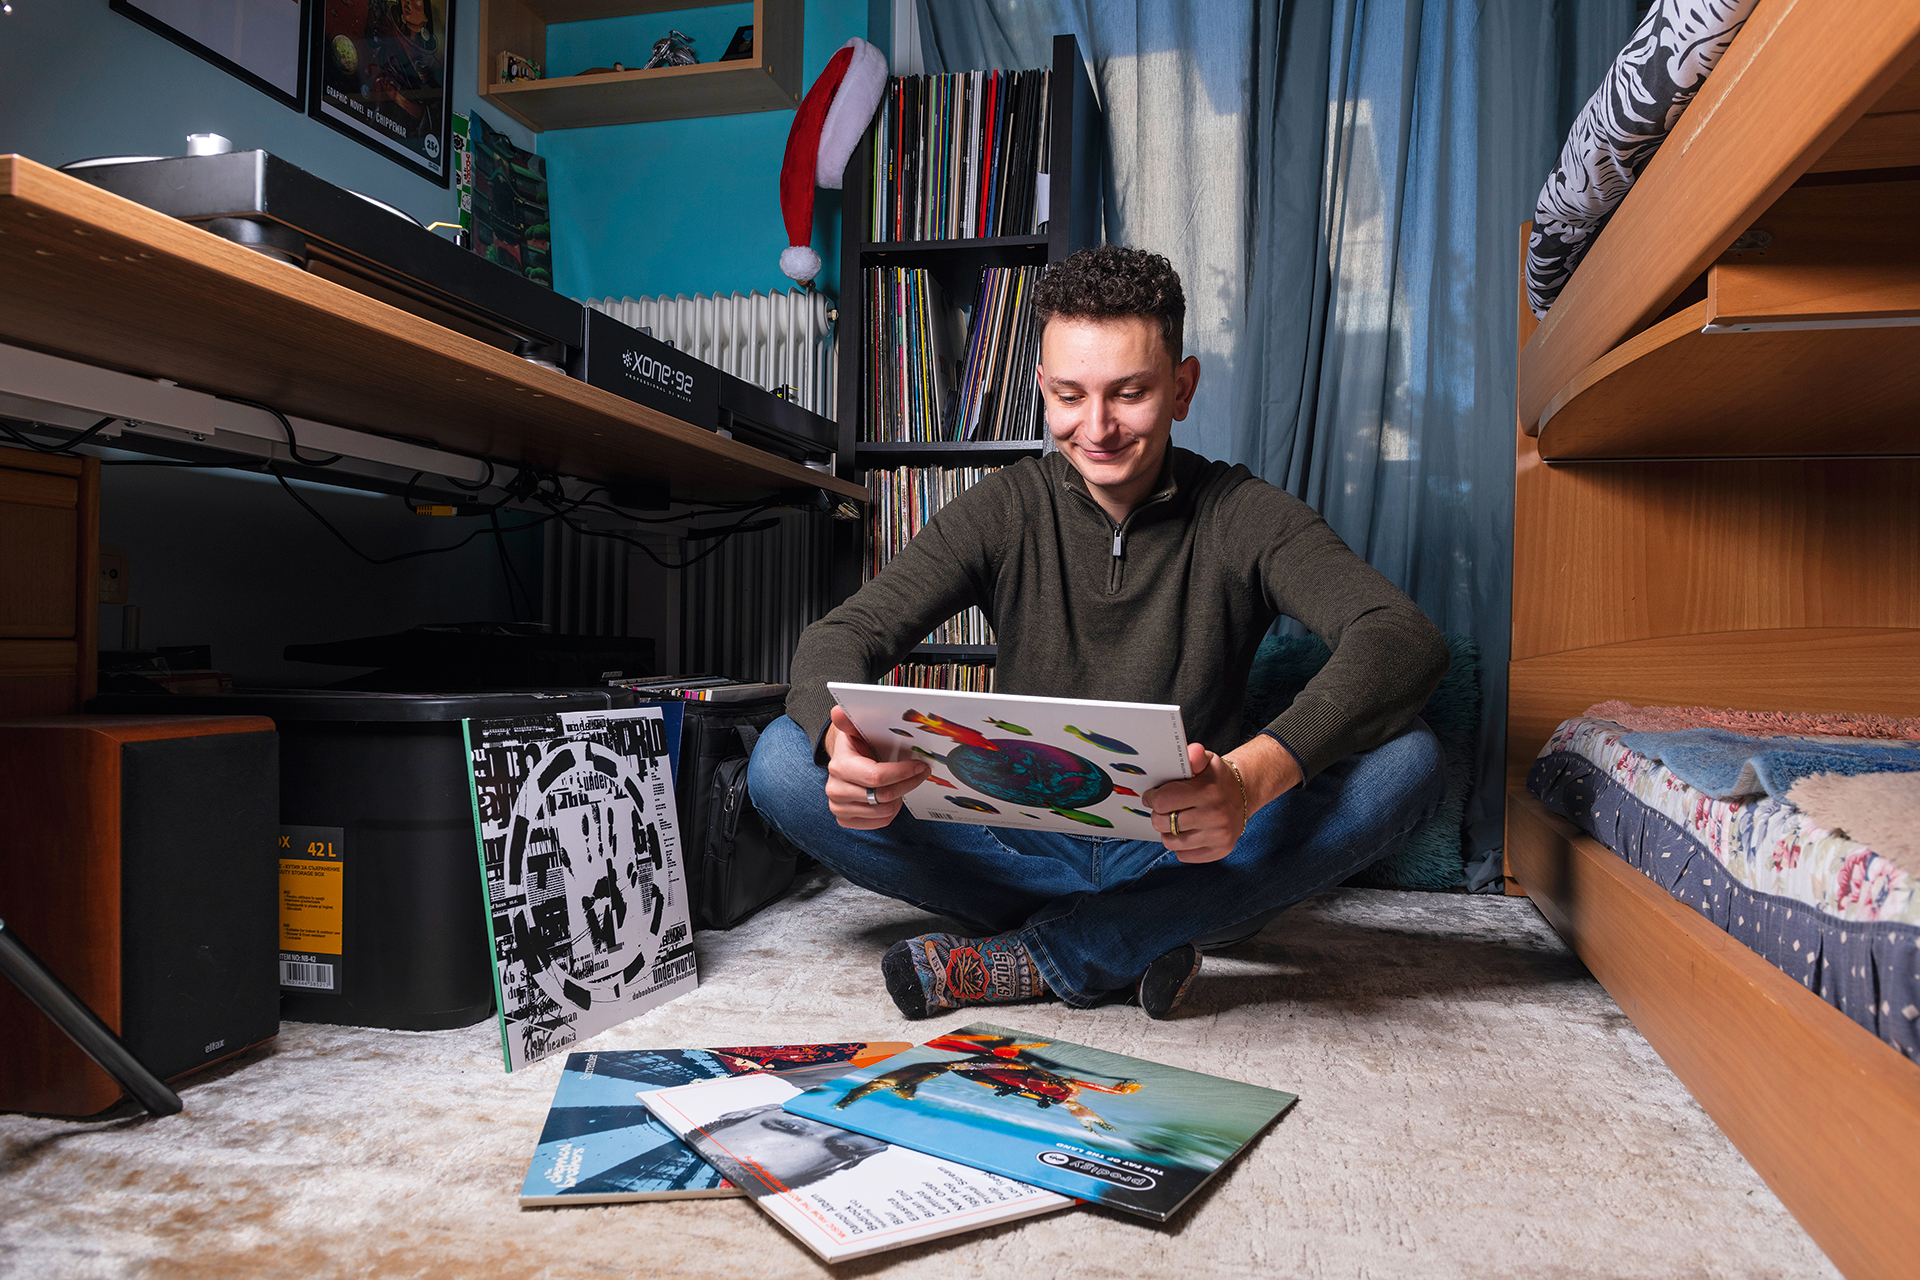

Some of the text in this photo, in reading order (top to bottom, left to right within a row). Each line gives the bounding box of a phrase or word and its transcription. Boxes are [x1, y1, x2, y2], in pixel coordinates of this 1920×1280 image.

[326, 85, 348, 104] GRAPHIC
[350, 99, 364, 114] NOVEL
[367, 108, 374, 119] BY
[308, 842, 336, 858] 42 L
[652, 951, 695, 984] underworld
[993, 952, 1010, 996] SOCKS
[205, 1040, 224, 1053] eltax
[580, 1054, 598, 1080] Surrender
[556, 1148, 585, 1188] brothers
[1056, 1142, 1164, 1176] THE FAT OF THE LAND
[938, 1166, 995, 1204] Primal Scream
[1069, 1160, 1146, 1186] prodigy
[896, 1190, 935, 1218] Brian Eno
[914, 1191, 950, 1214] Leftfield
[922, 1182, 965, 1211] New Order
[943, 1182, 980, 1207] Iggy Pop
[988, 1187, 1009, 1200] Pulp
[1005, 1186, 1023, 1198] Lou
[811, 1194, 863, 1235] Damon Albarn
[844, 1206, 878, 1231] Bedrock
[885, 1212, 904, 1225] Blur
[887, 1198, 919, 1221] Elastica
